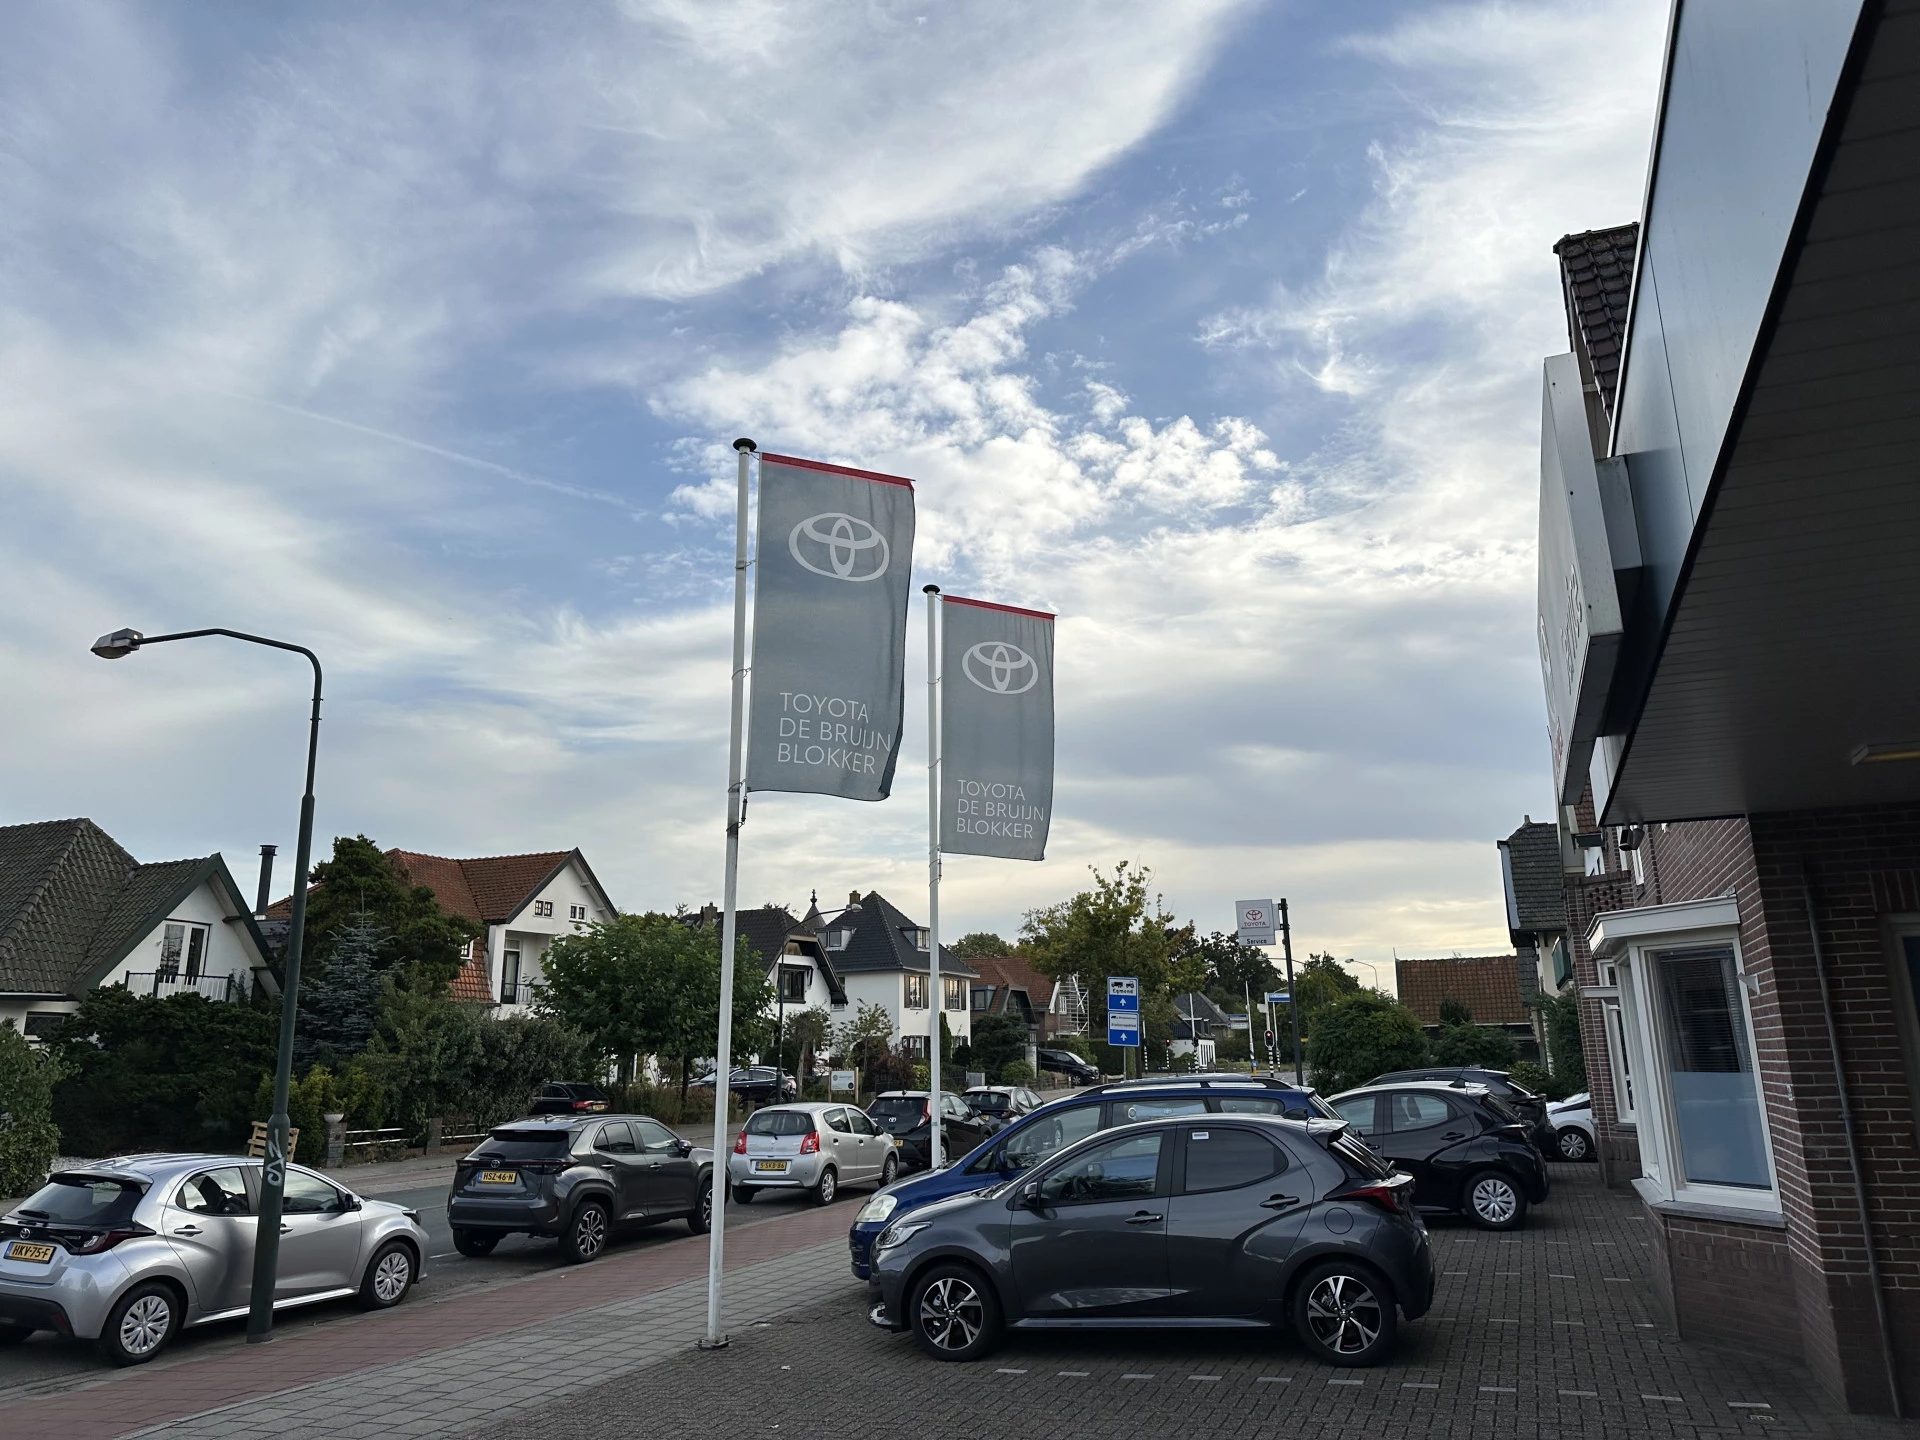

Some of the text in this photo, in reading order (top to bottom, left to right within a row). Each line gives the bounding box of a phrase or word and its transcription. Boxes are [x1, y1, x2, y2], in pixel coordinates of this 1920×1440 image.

[779, 692, 869, 724] TOYOTA
[779, 717, 891, 752] DE BRUIJN
[777, 743, 875, 775] BLOKKER
[957, 779, 1026, 801] TOYOTA
[957, 798, 1044, 822] DE BRUIJN
[956, 817, 1033, 839] BLOKKER
[482, 1172, 514, 1181] HSZ-46-N
[11, 1244, 51, 1259] HKV-75-F
